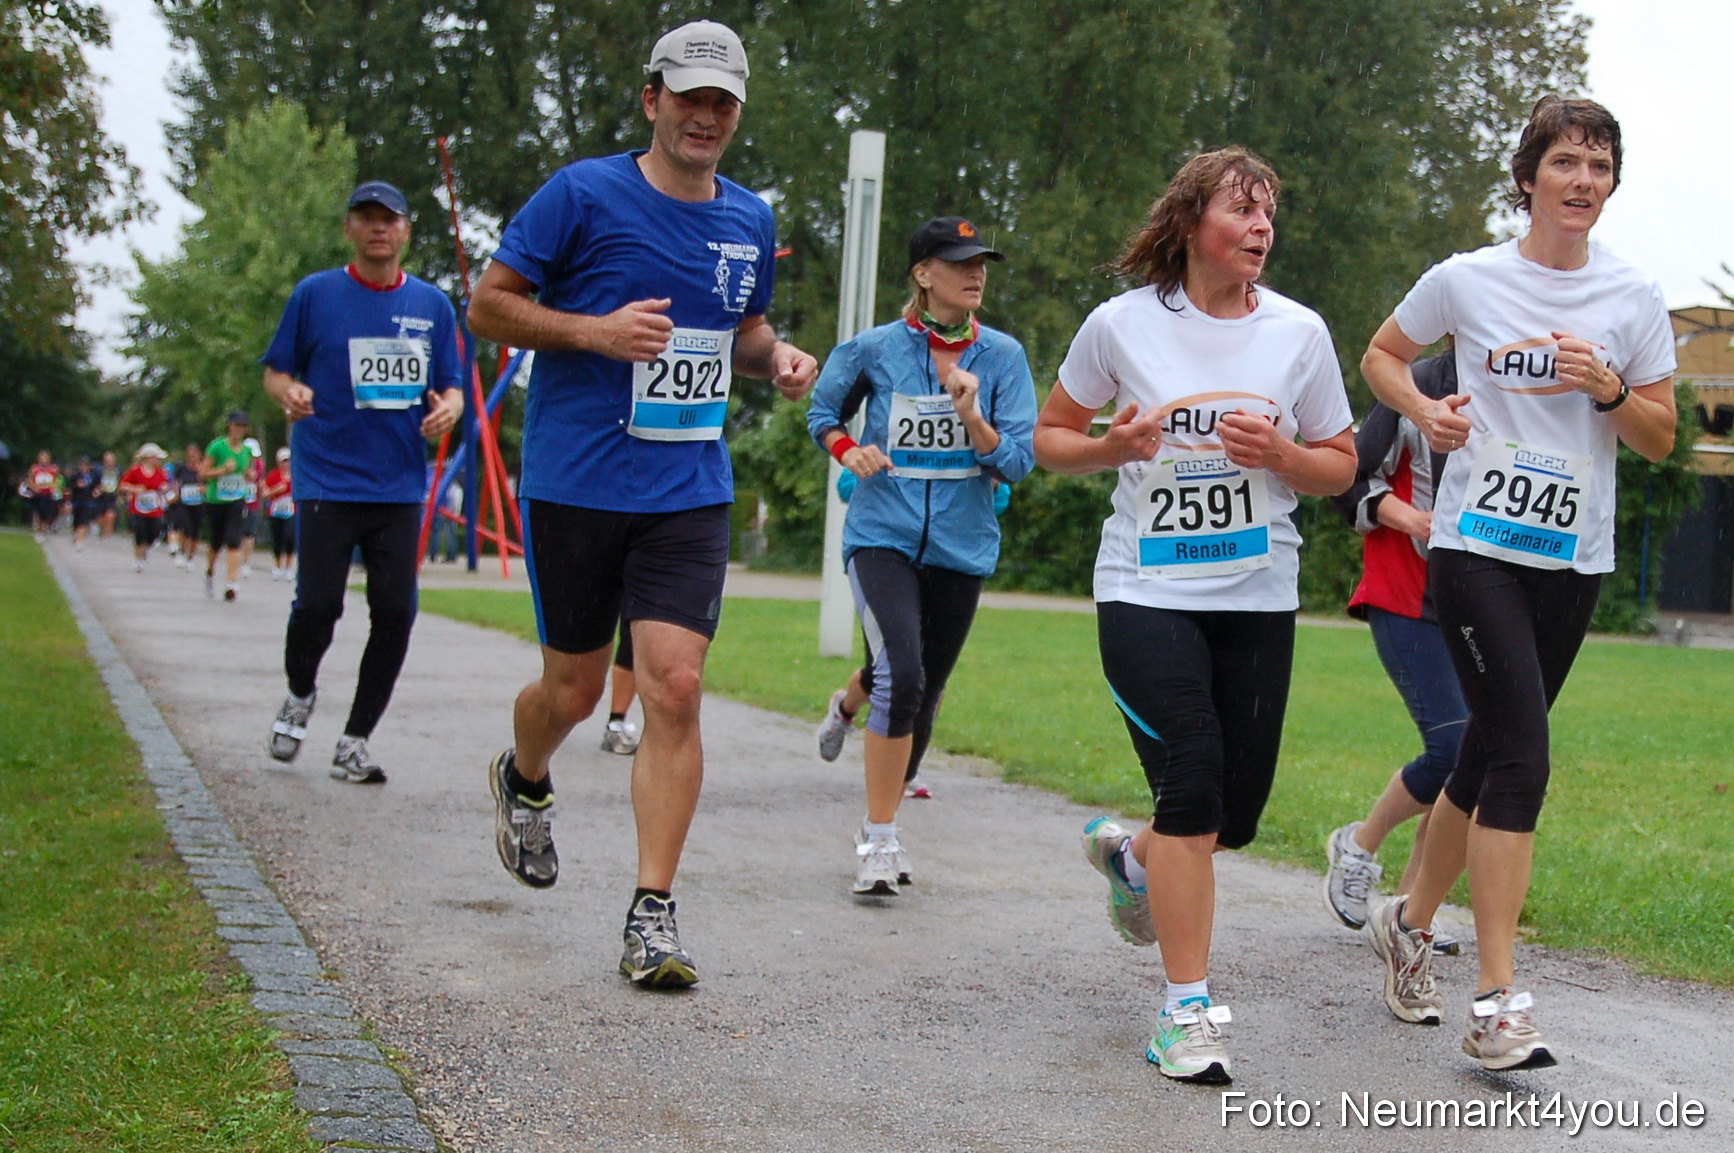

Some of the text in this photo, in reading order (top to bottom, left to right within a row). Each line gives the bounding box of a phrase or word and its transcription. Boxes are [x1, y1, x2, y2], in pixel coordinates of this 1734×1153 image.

[673, 336, 718, 350] BOCK
[360, 357, 420, 382] 2949
[646, 356, 725, 401] 2922
[679, 409, 697, 425] Uli
[898, 418, 971, 448] 2931
[1174, 458, 1229, 474] BOCK
[1515, 450, 1567, 470] BOCK
[1150, 479, 1253, 533] 2591
[1476, 469, 1580, 528] 2945
[1472, 519, 1563, 554] Heidemarie
[1176, 540, 1237, 560] Renate
